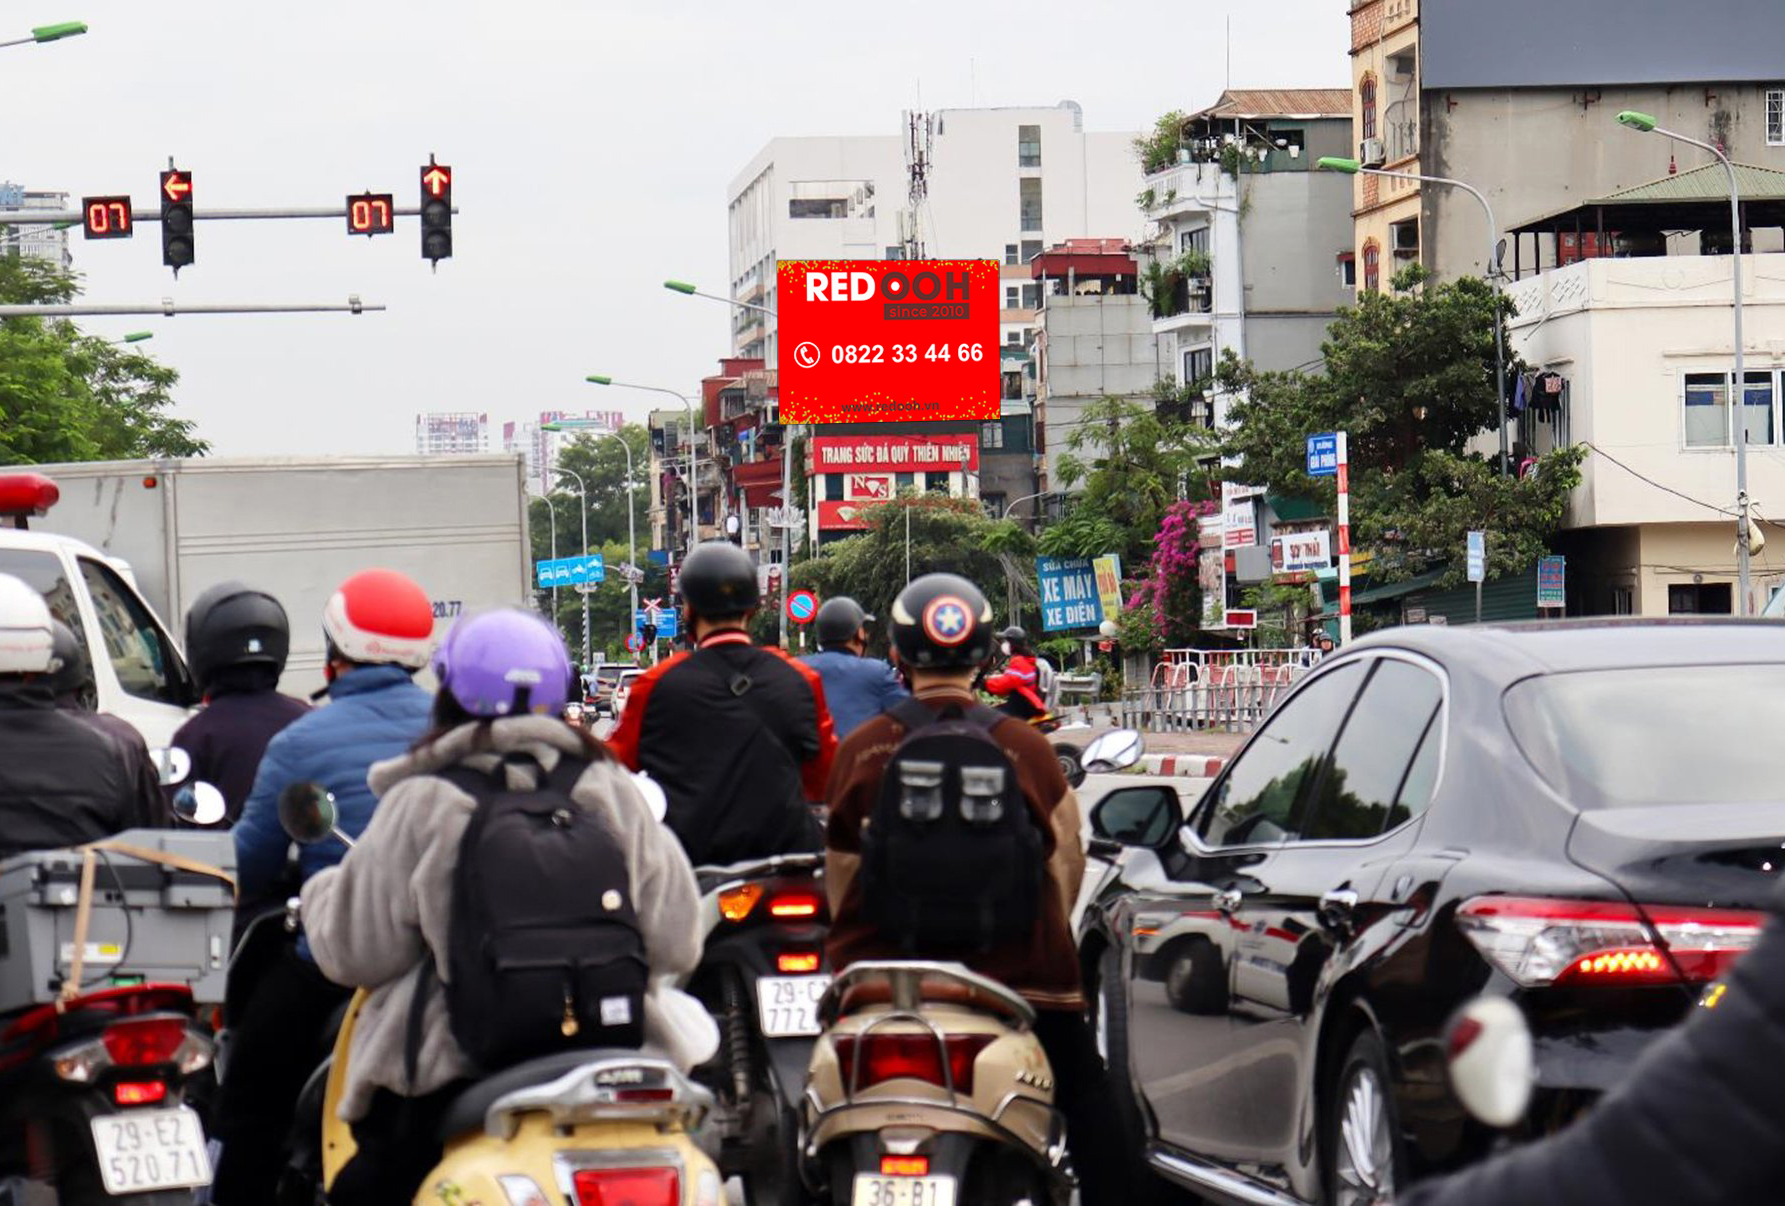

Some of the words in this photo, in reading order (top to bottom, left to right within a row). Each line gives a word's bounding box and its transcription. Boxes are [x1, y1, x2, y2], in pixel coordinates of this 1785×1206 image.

[90, 203, 125, 232] 07
[353, 201, 387, 229] 07
[806, 272, 876, 301] RED
[881, 272, 969, 300] OOH
[889, 306, 927, 317] since
[932, 305, 964, 317] 2010
[832, 345, 884, 364] 0822
[892, 344, 917, 363] 33
[925, 344, 951, 362] 44
[958, 343, 983, 361] 66
[841, 401, 940, 413] www.redooh.vn
[822, 446, 853, 464] TRANG
[855, 442, 876, 463] SỨC
[876, 442, 890, 463] ĐÁ
[891, 441, 909, 463] QUÝ
[913, 441, 939, 462] THIÊN
[1043, 559, 1061, 572] SỬA
[1042, 577, 1061, 603] XE
[1063, 569, 1092, 600] MÁY
[1046, 607, 1063, 626] XE
[1066, 601, 1096, 627] ĐIỆN
[767, 1007, 820, 1032] 772.
[111, 1117, 185, 1151] 29-E2
[111, 1150, 200, 1186] 520.71
[868, 1180, 936, 1206] 36-B1
